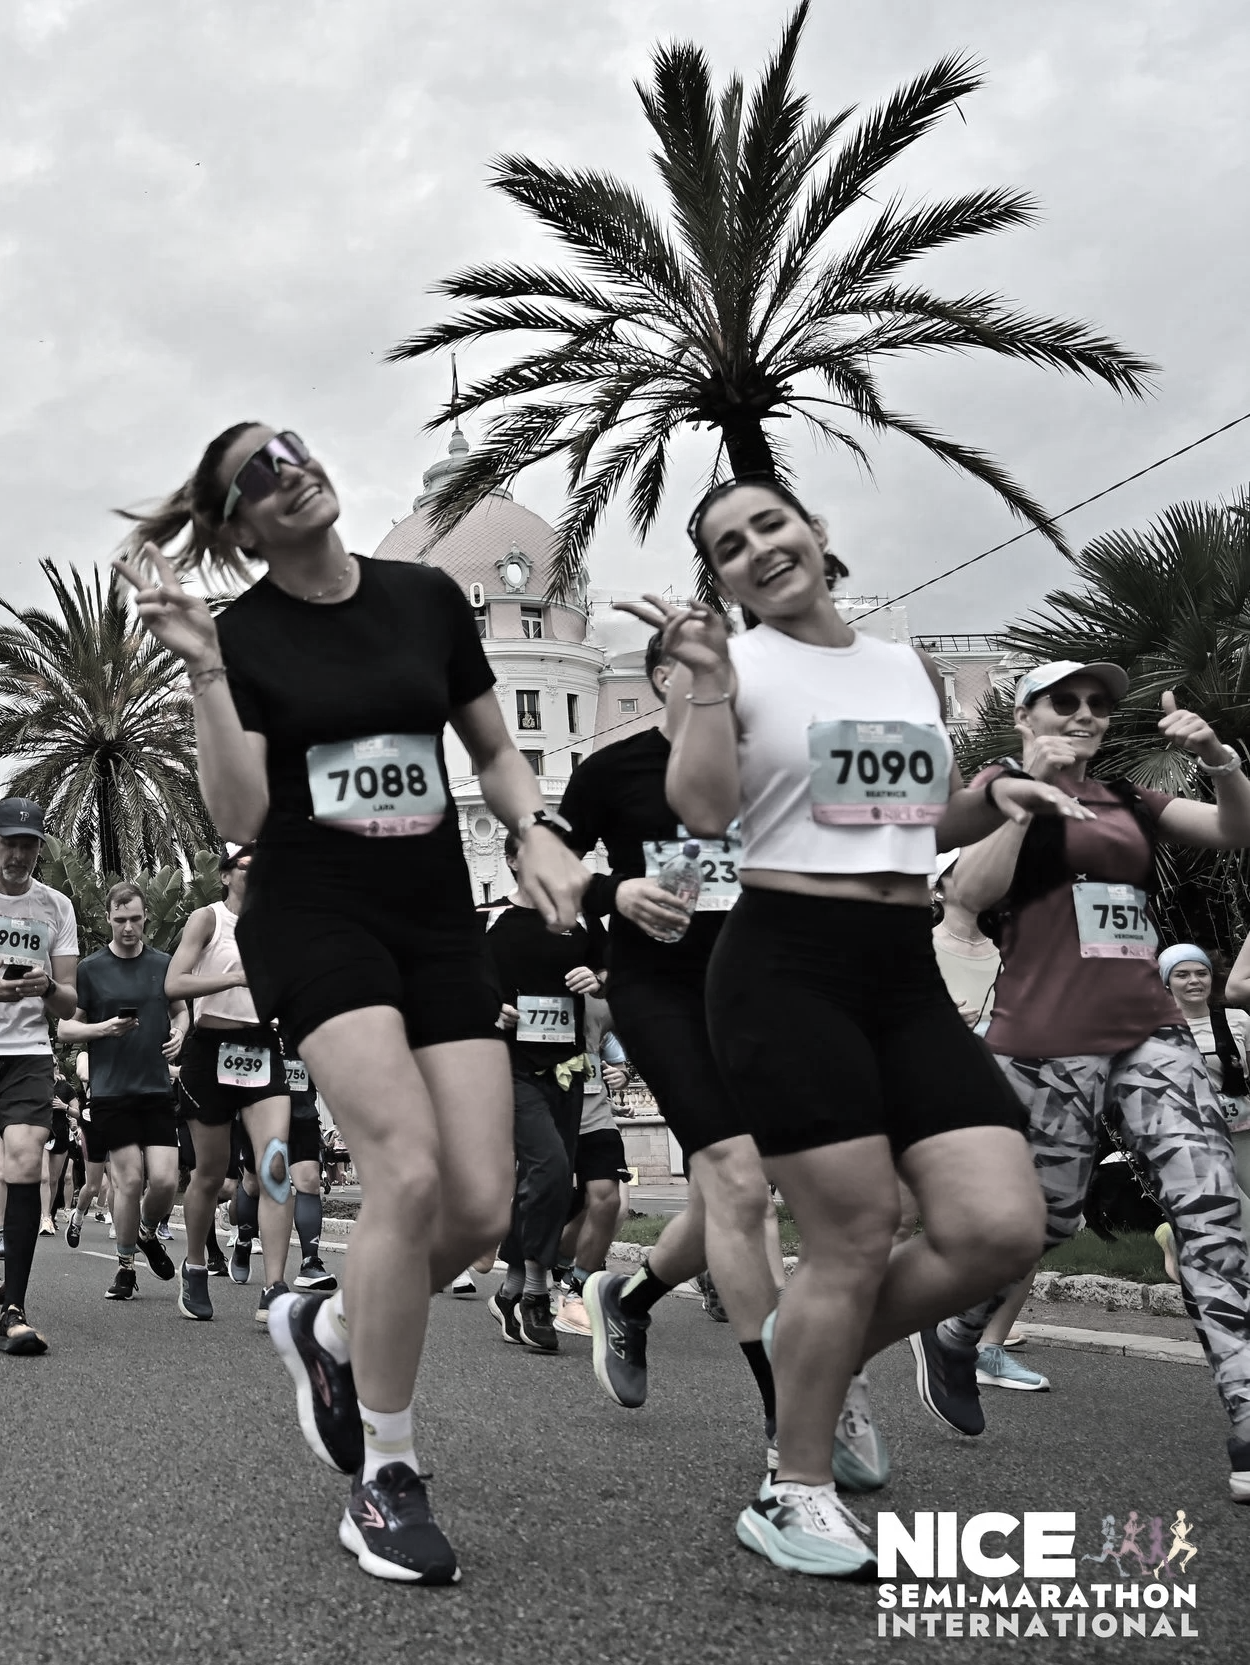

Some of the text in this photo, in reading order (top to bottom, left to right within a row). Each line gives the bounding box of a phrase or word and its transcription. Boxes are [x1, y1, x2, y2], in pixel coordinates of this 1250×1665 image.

[830, 750, 935, 785] 7090
[327, 763, 428, 802] 7088
[528, 1009, 569, 1026] 7778
[224, 1055, 263, 1073] 6939
